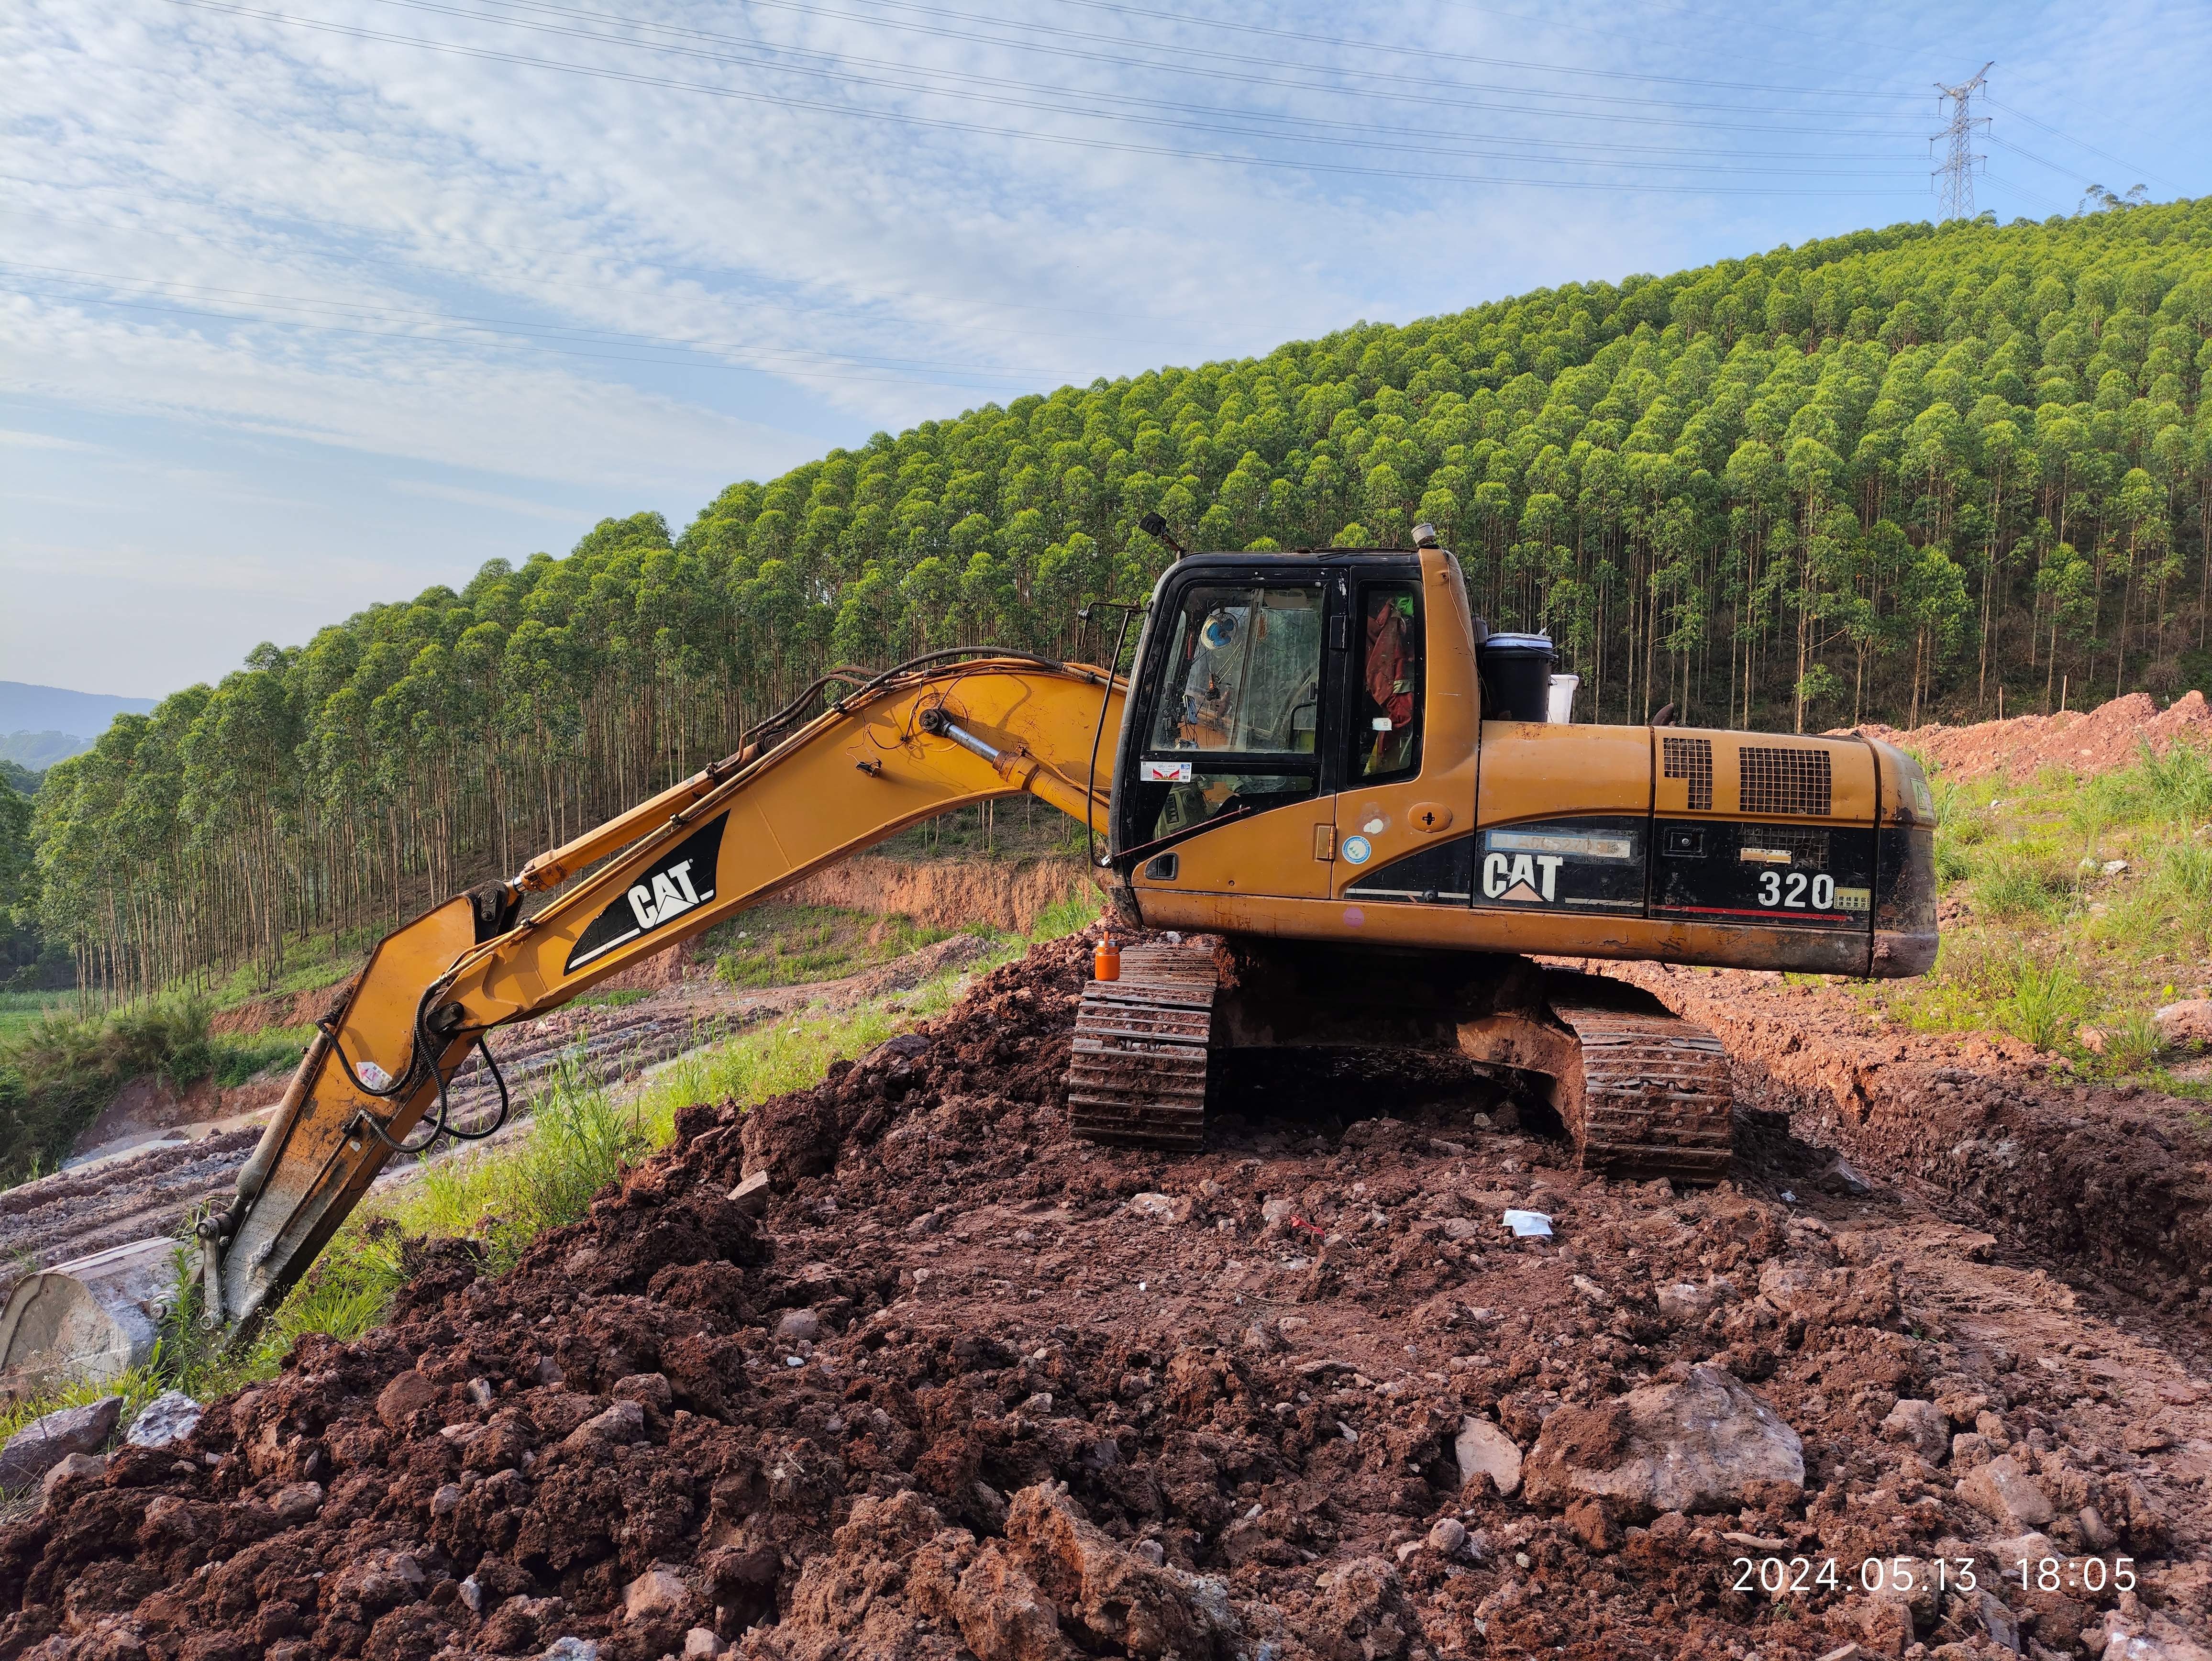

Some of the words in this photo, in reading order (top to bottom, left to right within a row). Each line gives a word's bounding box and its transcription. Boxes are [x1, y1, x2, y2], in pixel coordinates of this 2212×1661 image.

[628, 860, 700, 929] CAT
[1483, 853, 1563, 902] CAT
[1758, 871, 1834, 909] 320
